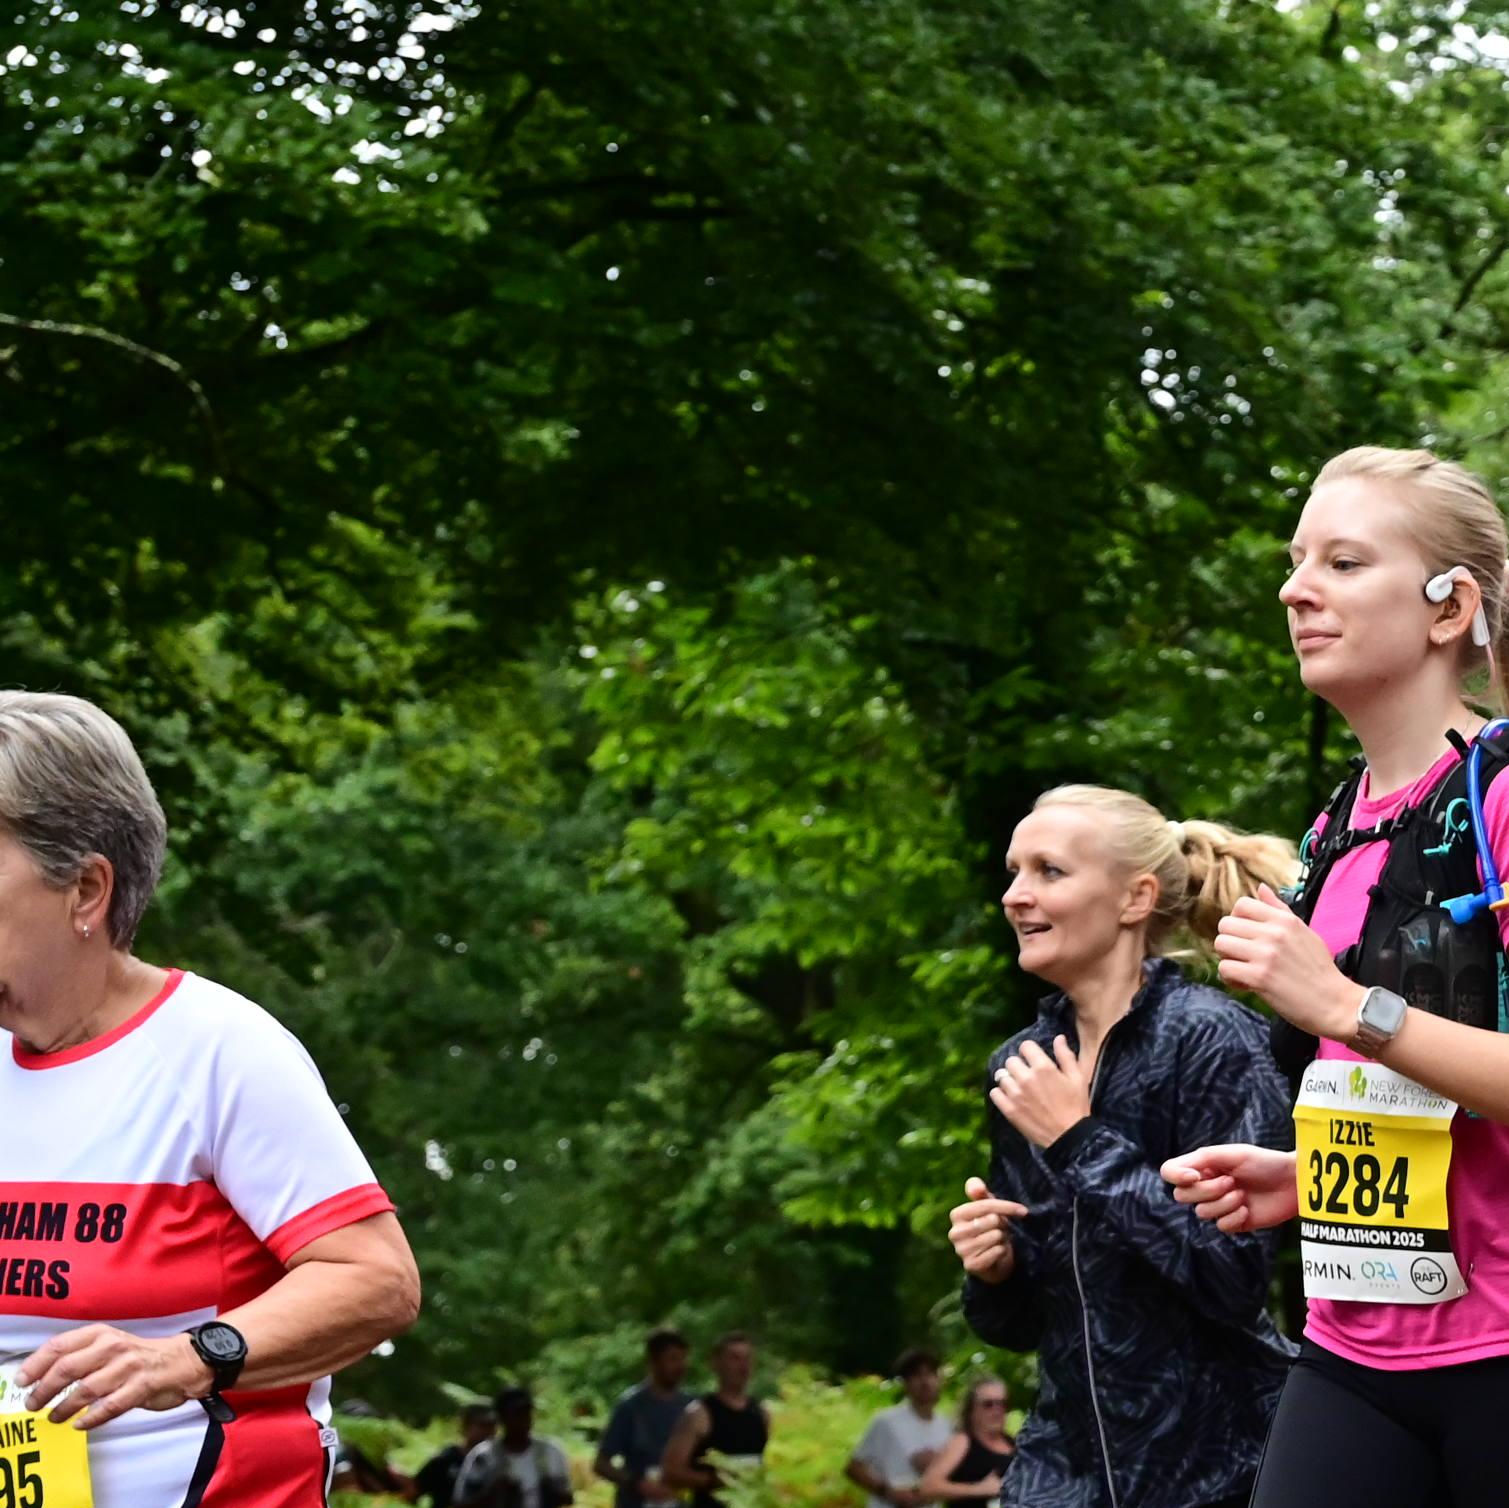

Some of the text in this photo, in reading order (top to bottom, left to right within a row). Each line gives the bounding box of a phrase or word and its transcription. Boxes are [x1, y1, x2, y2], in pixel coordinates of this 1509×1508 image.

[1370, 1079, 1442, 1097] NEW FORE
[1369, 1093, 1448, 1110] MARATHON
[1330, 1118, 1375, 1147] IZZIE
[1308, 1149, 1410, 1219] 3284
[74, 1202, 127, 1243] 88
[1301, 1222, 1425, 1248] HALF MARATHON 2025
[1360, 1260, 1398, 1281] ORA
[1414, 1272, 1442, 1284] RAFT
